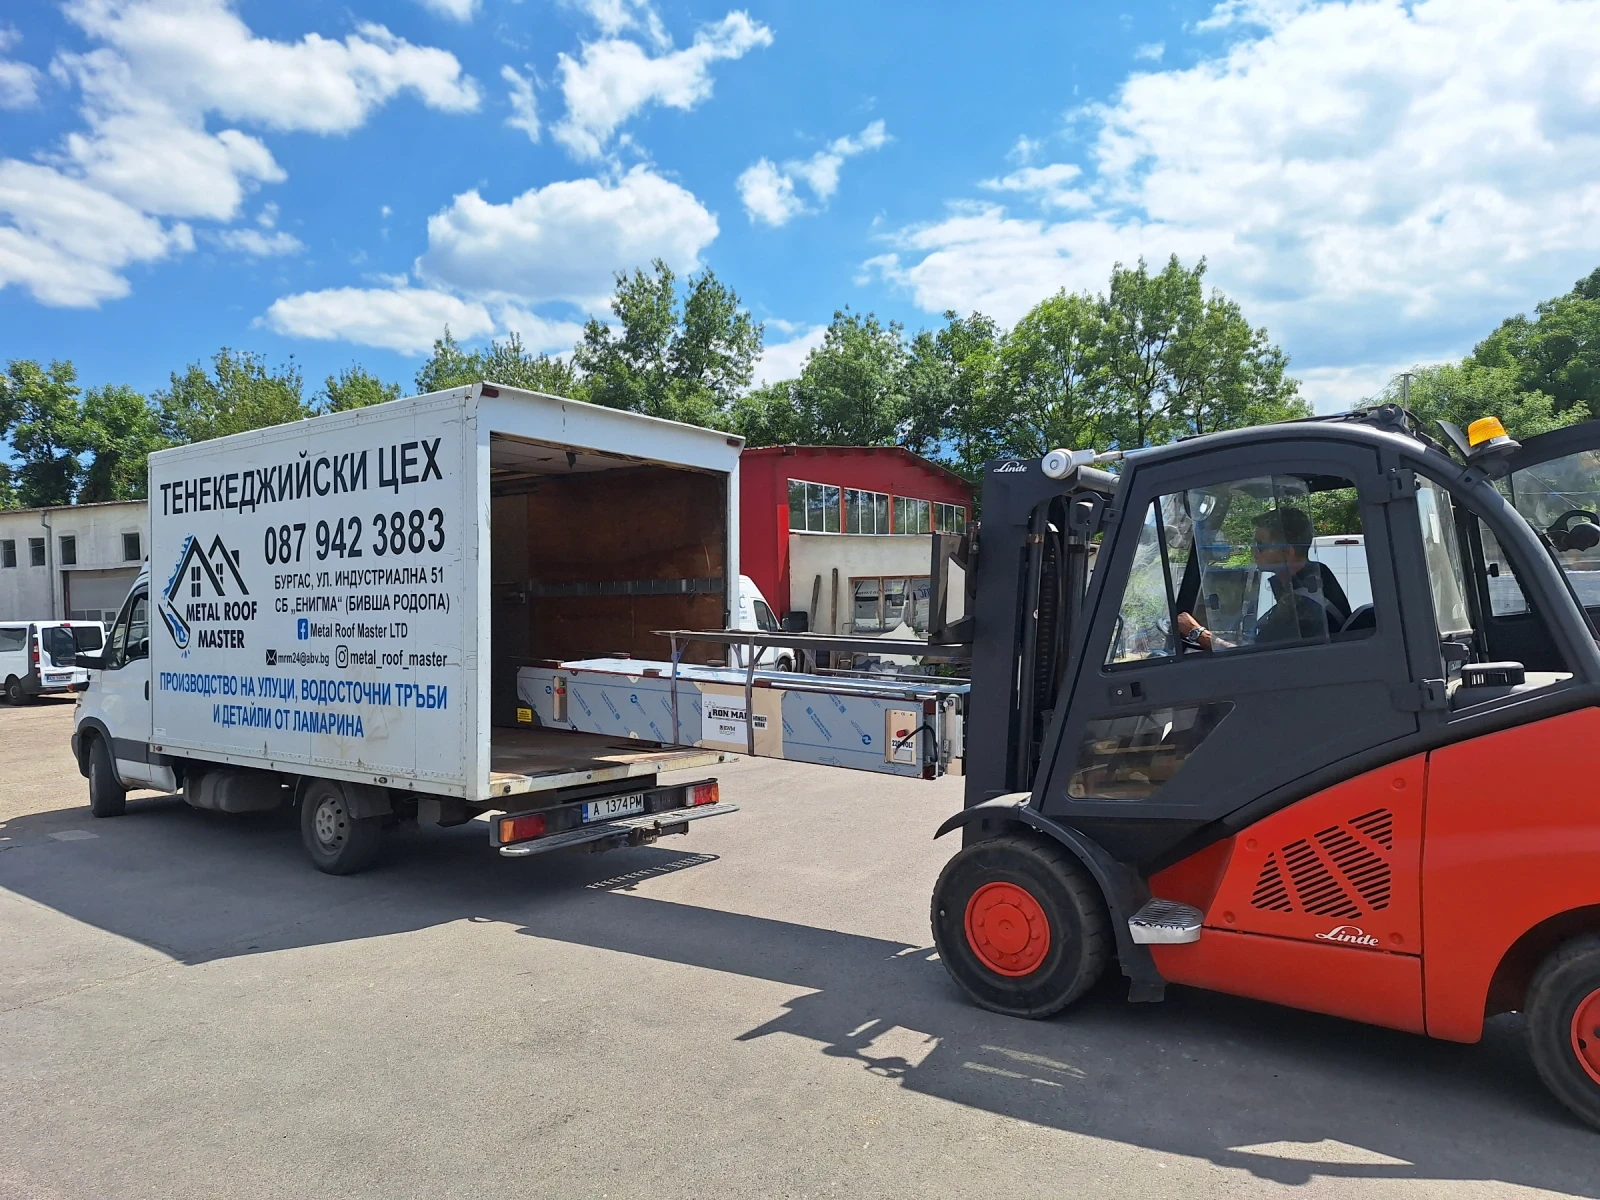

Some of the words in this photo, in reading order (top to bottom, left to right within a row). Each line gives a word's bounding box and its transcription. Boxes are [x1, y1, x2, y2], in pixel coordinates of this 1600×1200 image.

[160, 450, 368, 516] ТЕНЕКЕДЖИЙСКИ
[378, 437, 443, 494] ЦЕХ
[993, 460, 1028, 472] Linde
[264, 523, 306, 565] 087
[315, 516, 362, 561] 942
[372, 507, 445, 557] 3883
[274, 573, 314, 590] БУРГАС,
[316, 572, 332, 588] УЛ.
[335, 567, 428, 588] ИНДУСТРИАЛНА
[430, 566, 444, 584] 51
[186, 602, 220, 621] METAL
[224, 601, 257, 621] ROOF
[275, 598, 288, 612] СБ
[291, 596, 343, 615] „ЕНИГМА“
[345, 594, 390, 615] (БИВША
[393, 593, 450, 614] РОДОПА)
[198, 630, 245, 649] MASTER
[310, 622, 332, 638] Metal
[335, 622, 356, 638] Roof
[357, 623, 387, 638] Master
[389, 622, 408, 638] LTD
[278, 652, 330, 666] mrm24@abv.bg
[350, 650, 448, 670] metal_roof_master
[160, 672, 238, 698] ПРОИЗВОДСТВО
[240, 676, 256, 696] НА
[258, 677, 298, 703] УЛУЦИ,
[301, 679, 391, 706] ВОДОСТОЧНИ
[395, 683, 447, 709] ТРЪБИ
[213, 703, 220, 723] И
[222, 701, 271, 728] ДЕТАЙЛИ
[275, 708, 290, 730] ОТ
[293, 710, 364, 738] ЛАМАРИНА
[593, 803, 600, 816] A
[606, 797, 628, 813] 1374
[629, 794, 642, 809] PM
[1315, 925, 1379, 946] Linde
